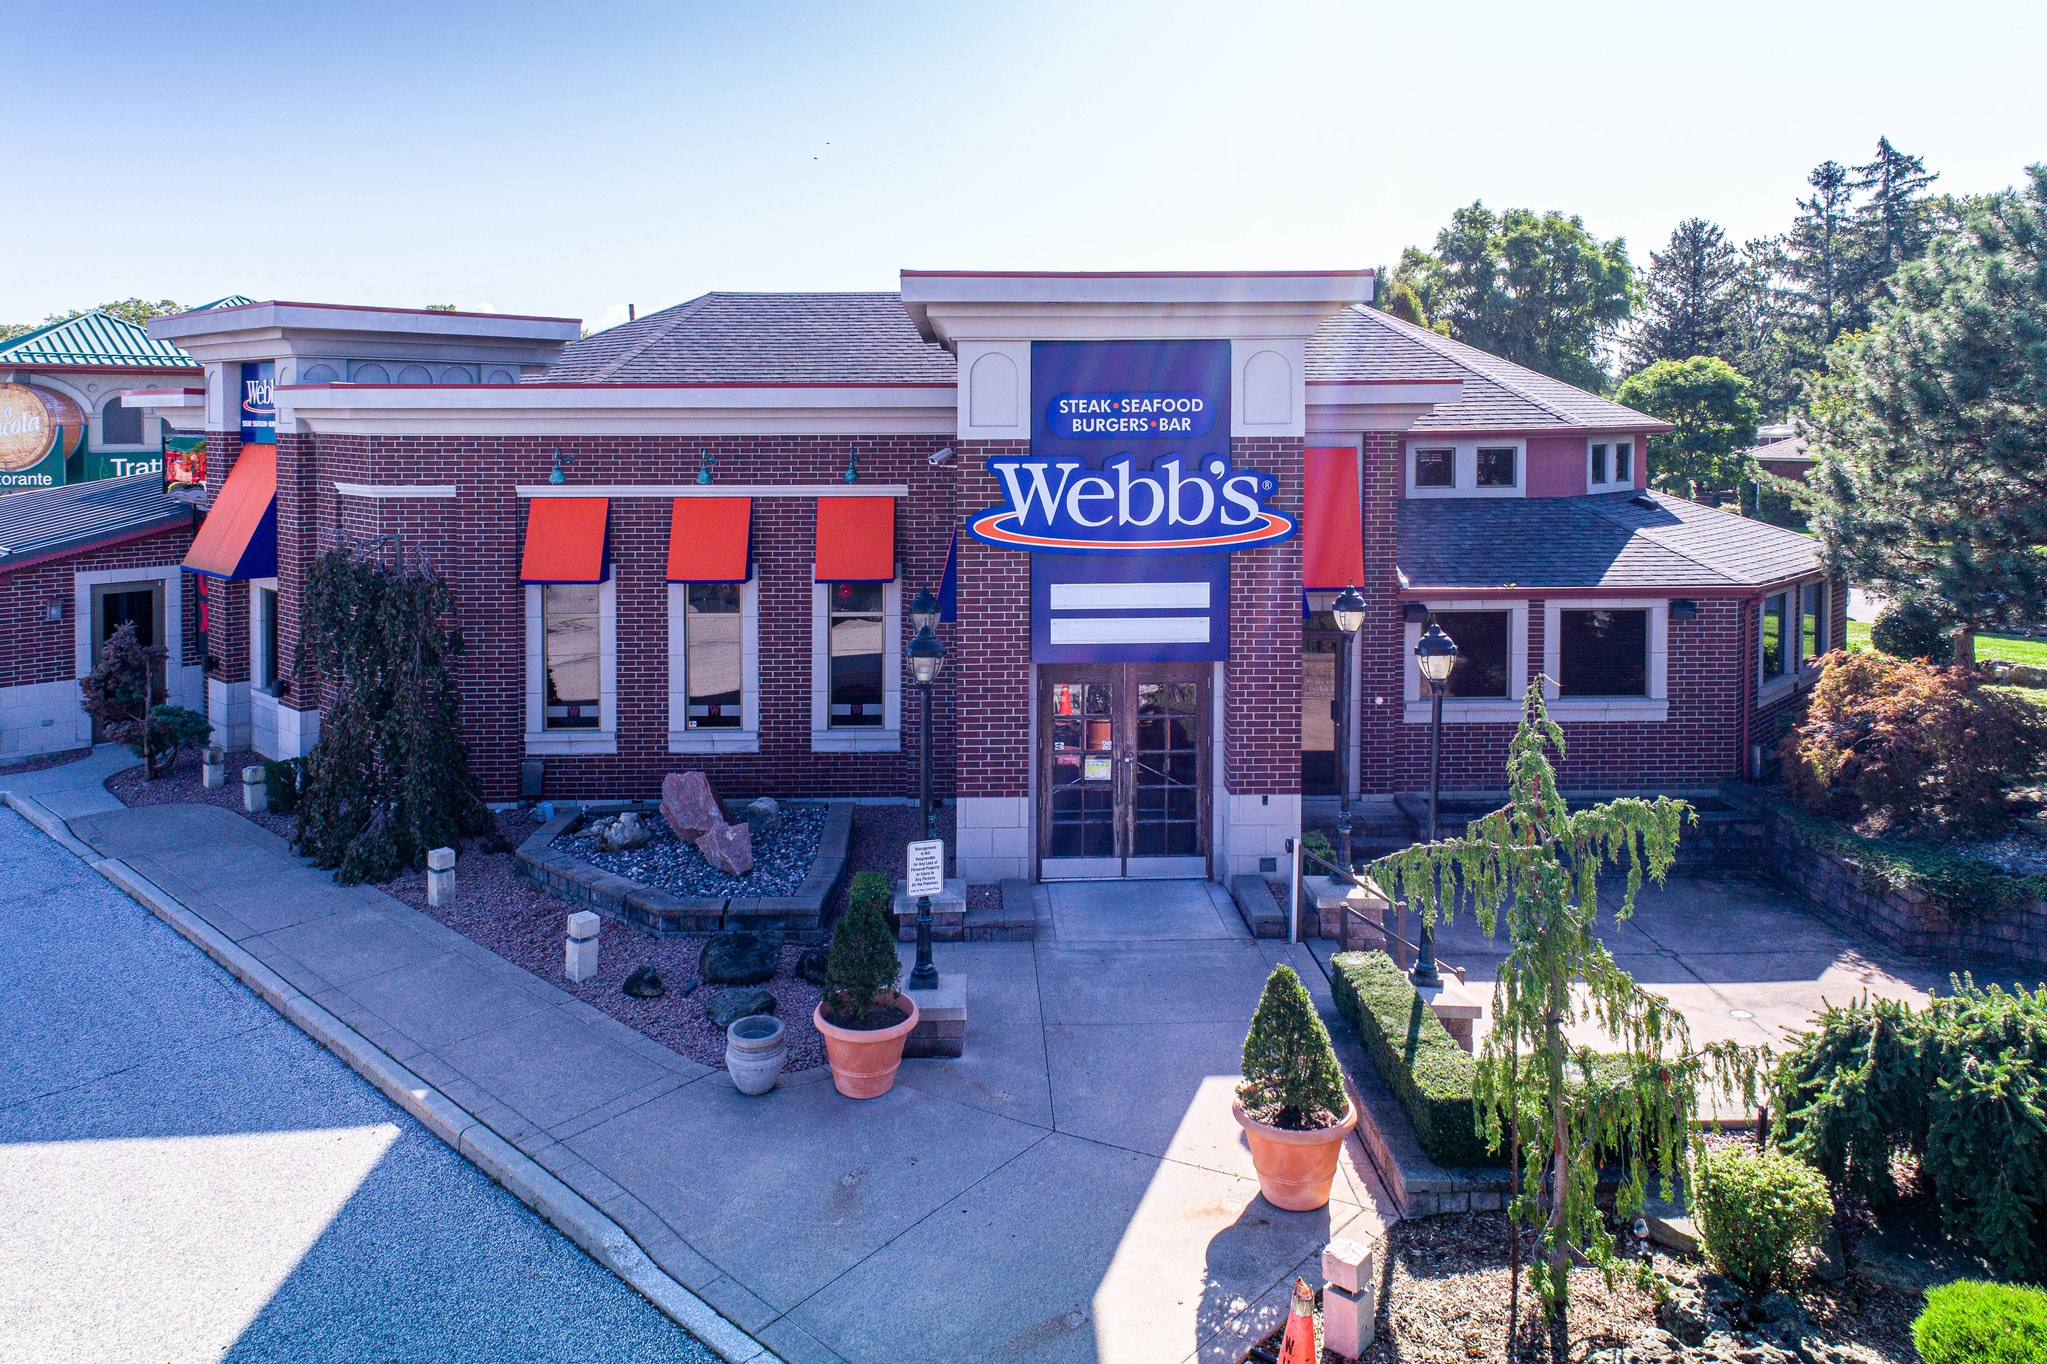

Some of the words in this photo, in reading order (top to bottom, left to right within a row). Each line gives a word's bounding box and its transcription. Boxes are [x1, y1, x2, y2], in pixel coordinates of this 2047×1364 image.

[1059, 399, 1111, 413] STEAK
[1121, 398, 1204, 413] SEAFOOD
[1072, 418, 1149, 432] BURGERS
[1159, 417, 1191, 431] BAR
